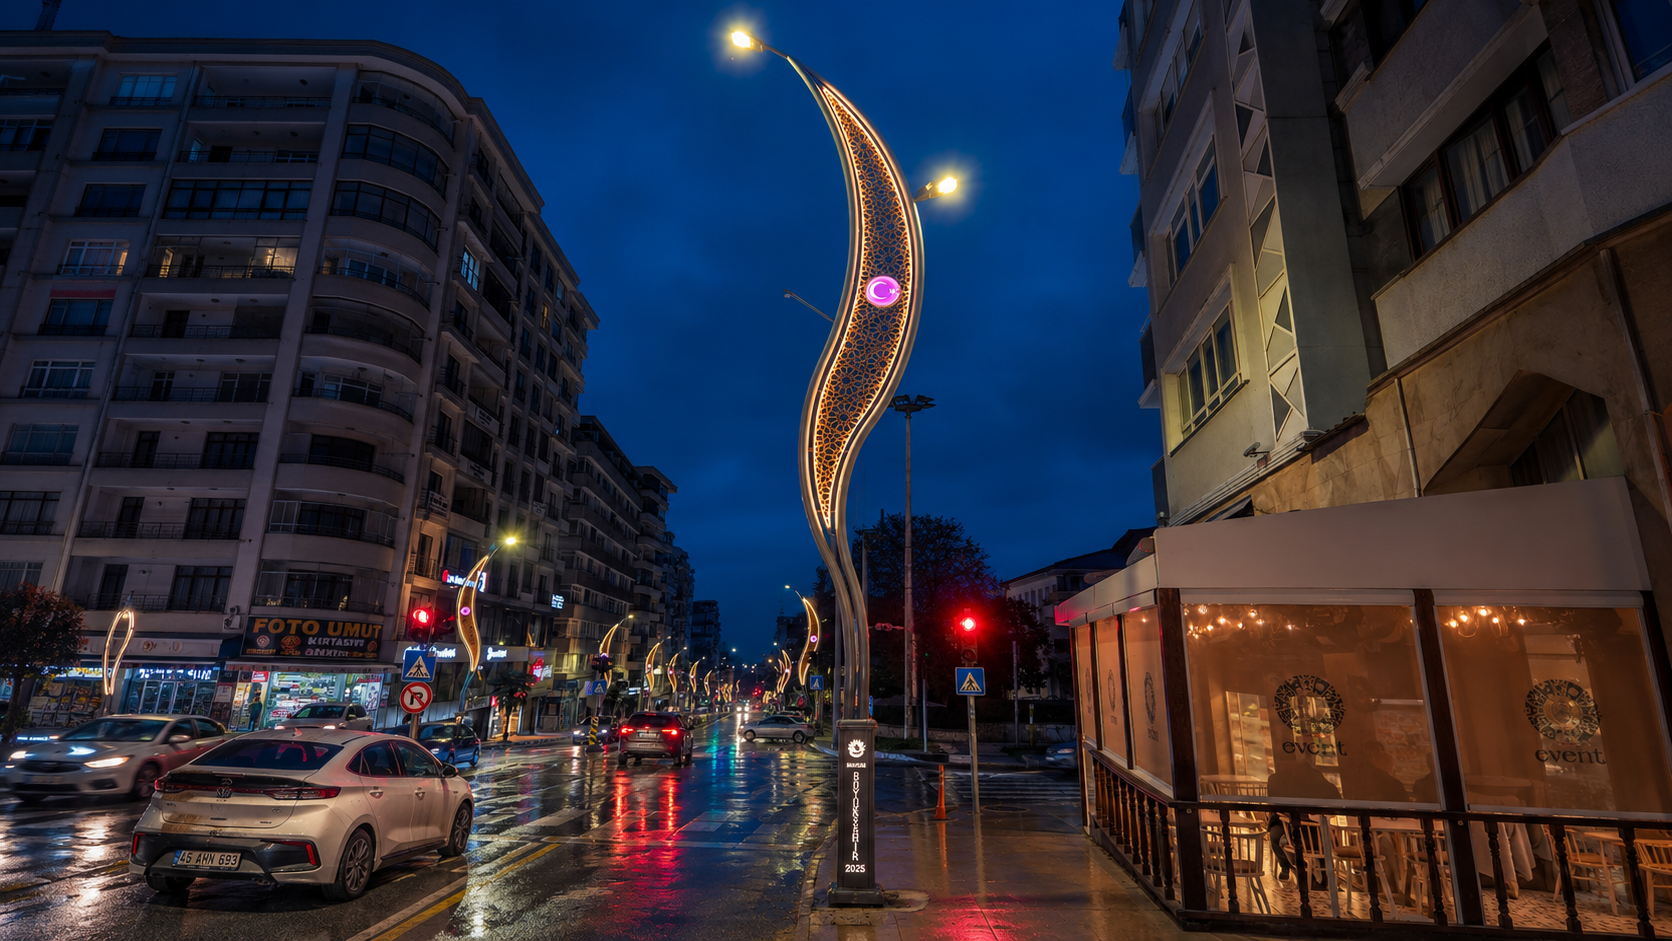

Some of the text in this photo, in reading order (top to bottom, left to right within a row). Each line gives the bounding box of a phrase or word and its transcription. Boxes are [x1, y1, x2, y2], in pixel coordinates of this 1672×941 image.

[252, 618, 382, 639] FOTO UMUT
[1535, 748, 1606, 765] event
[179, 852, 238, 866] 45 AHN 693
[845, 864, 866, 873] 2025
